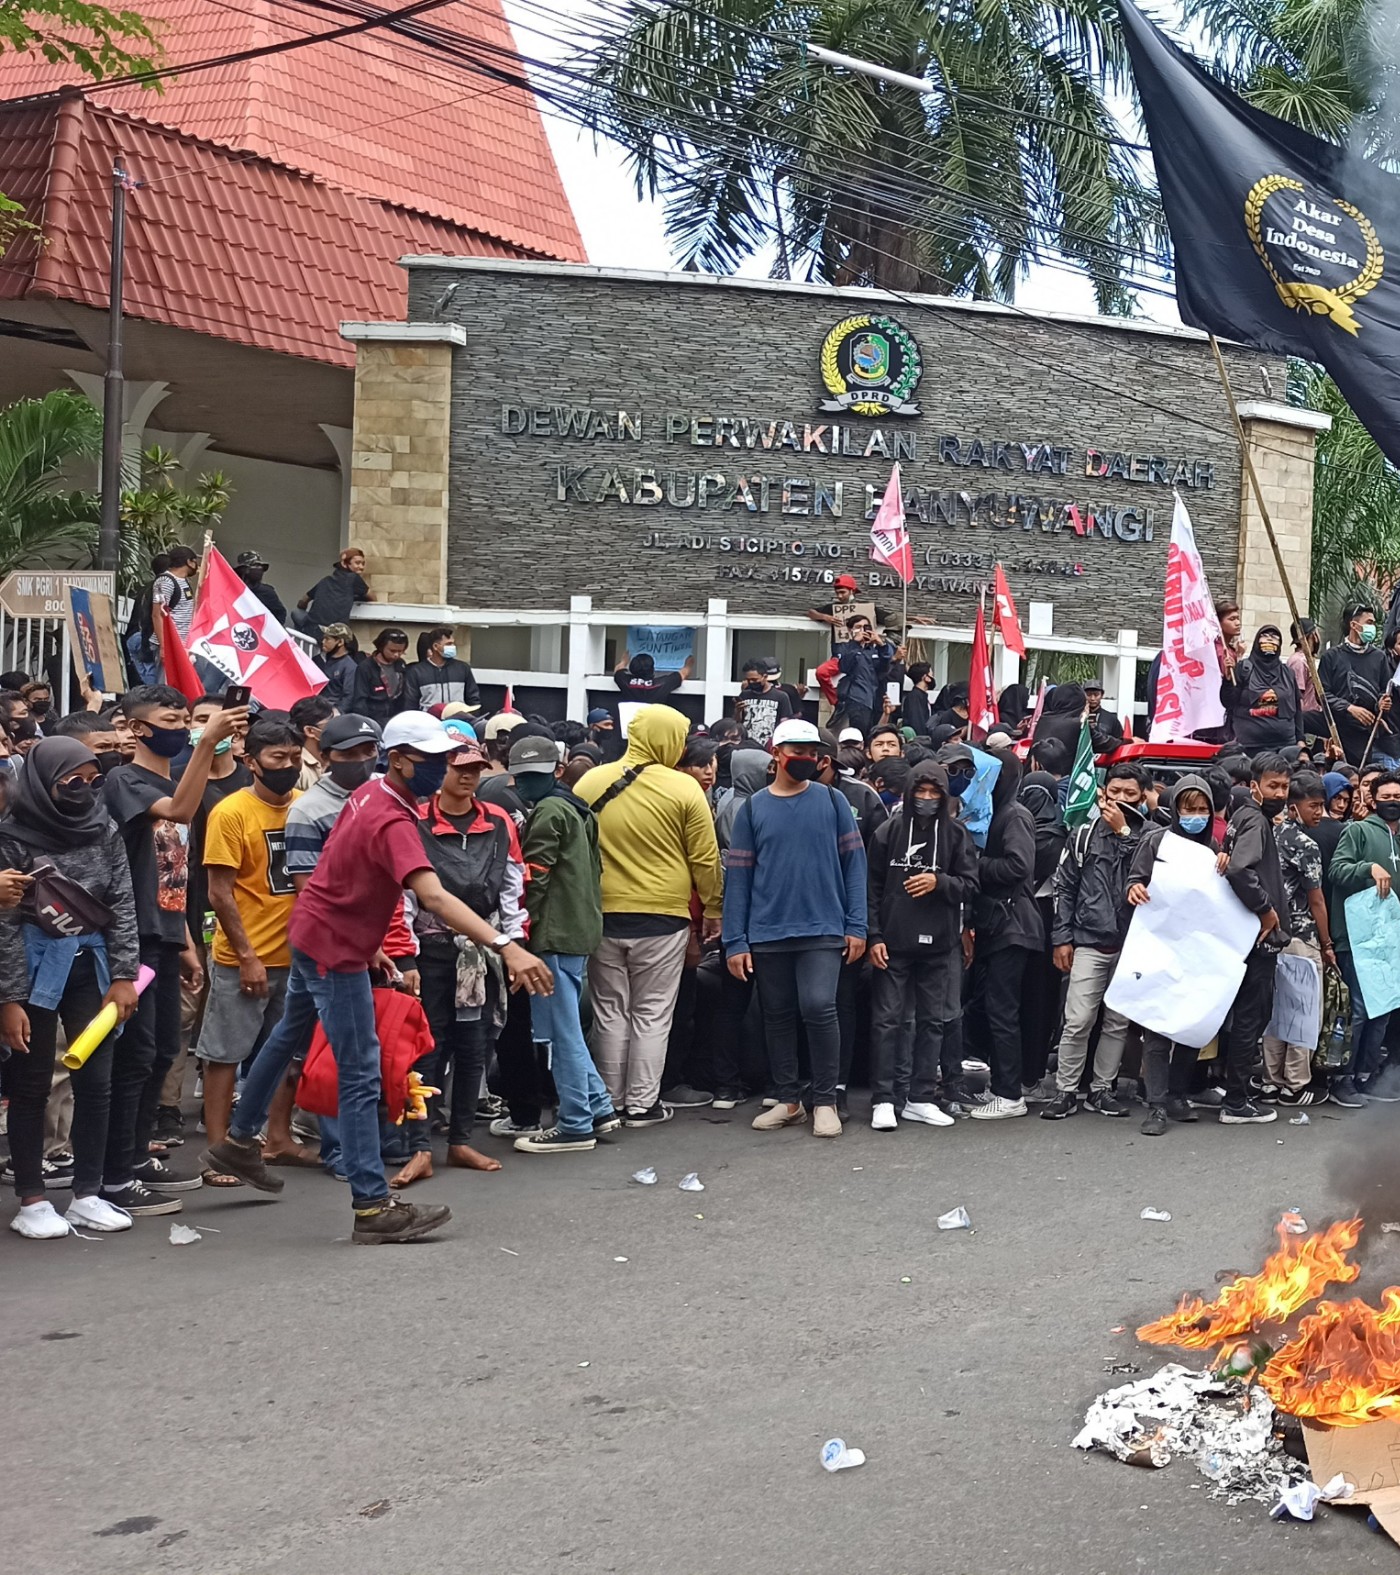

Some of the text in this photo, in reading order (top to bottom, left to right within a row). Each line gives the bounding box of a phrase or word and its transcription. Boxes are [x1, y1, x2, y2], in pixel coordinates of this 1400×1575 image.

[1293, 199, 1342, 226] Akar
[1292, 217, 1336, 245] Desa
[1266, 227, 1359, 268] Indonesia
[851, 392, 890, 402] DPRD
[501, 404, 1215, 488] DEWAN PERWAKILAN RAKYAT DAERAH
[556, 465, 843, 517] KABUPATEN
[720, 536, 805, 555] SUCIPTO
[16, 577, 33, 596] SMK
[36, 577, 53, 596] PGRI
[55, 577, 60, 596] 1
[868, 572, 998, 595] BAYUWANG
[834, 605, 856, 614] DPR
[41, 905, 84, 936] FILA
